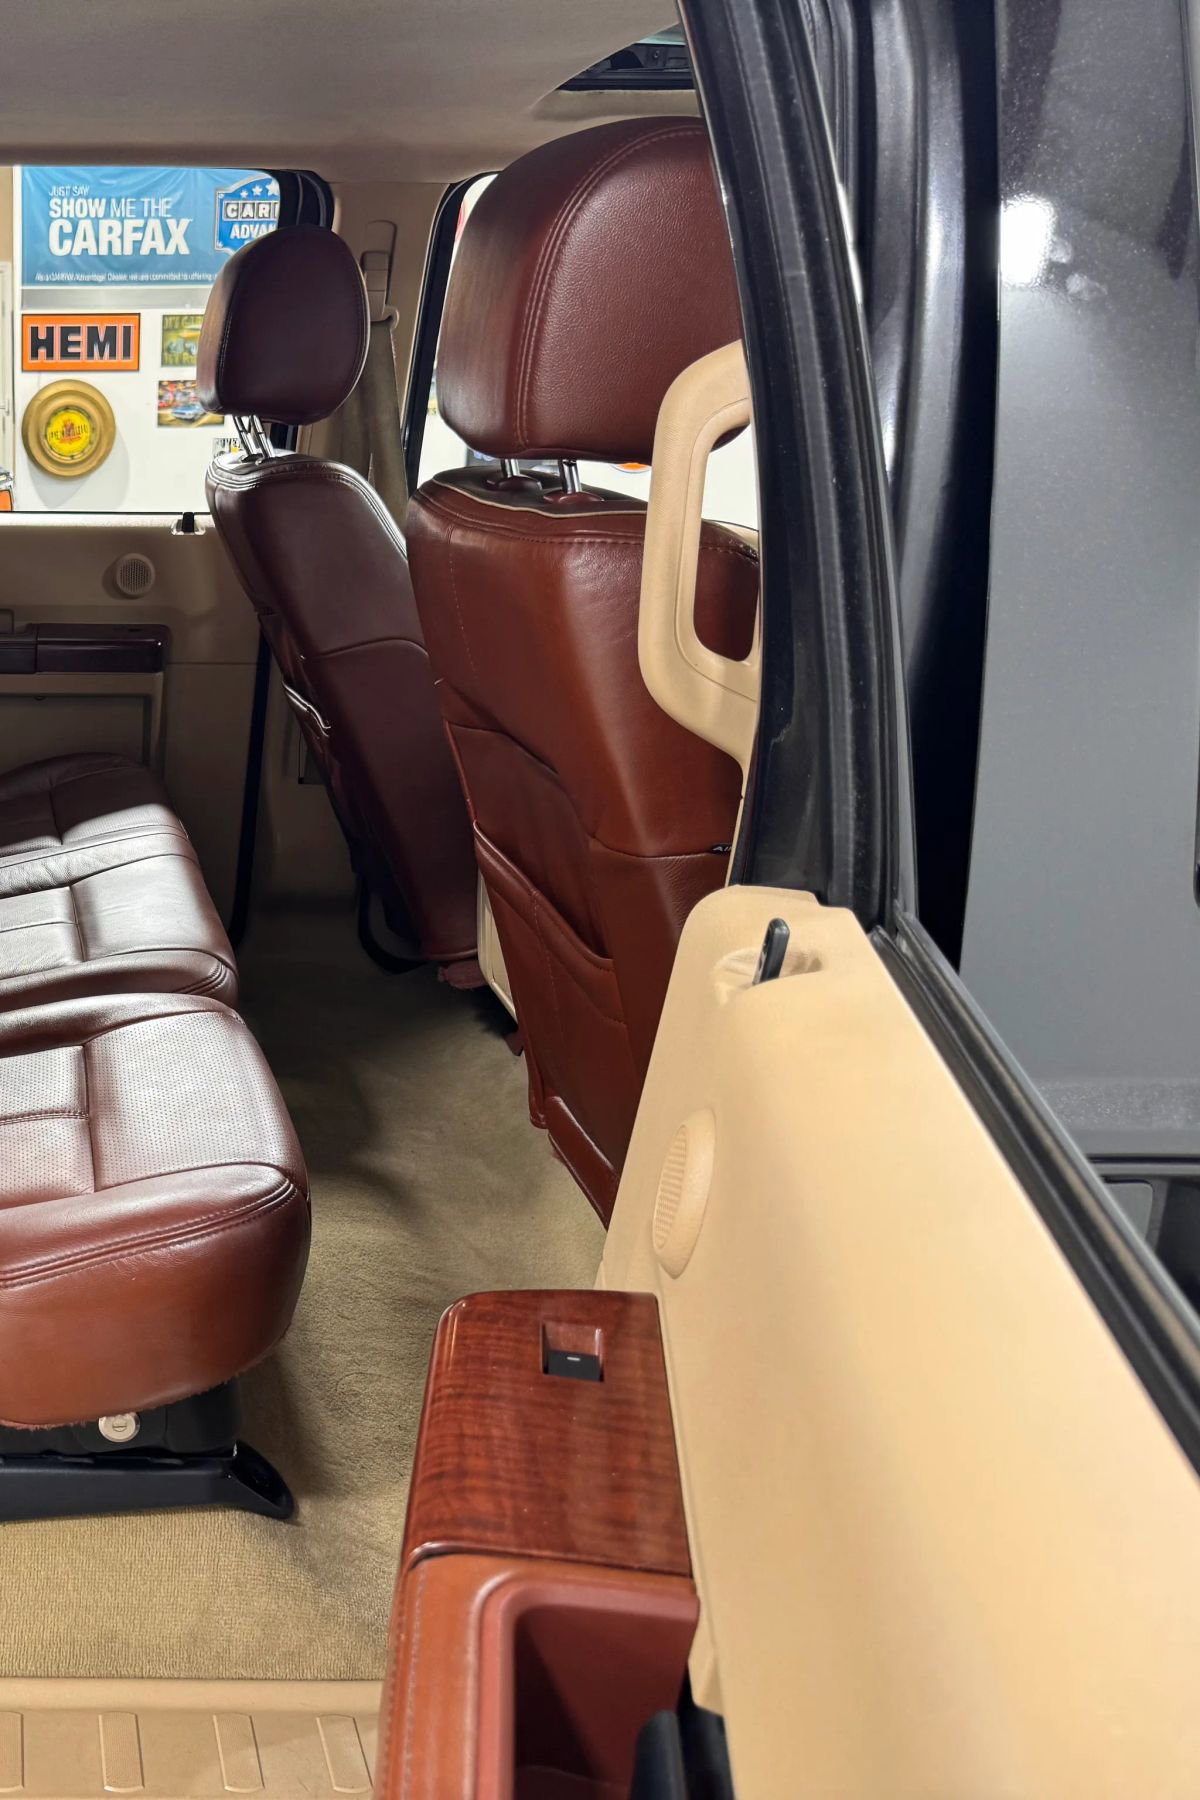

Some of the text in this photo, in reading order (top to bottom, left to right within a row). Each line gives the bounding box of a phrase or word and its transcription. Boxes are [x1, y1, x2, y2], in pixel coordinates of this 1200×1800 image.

[49, 185, 90, 197] JUST SAY
[49, 197, 172, 218] SHOW ME THE
[48, 218, 191, 257] CARFAX
[29, 324, 133, 361] HEMI
